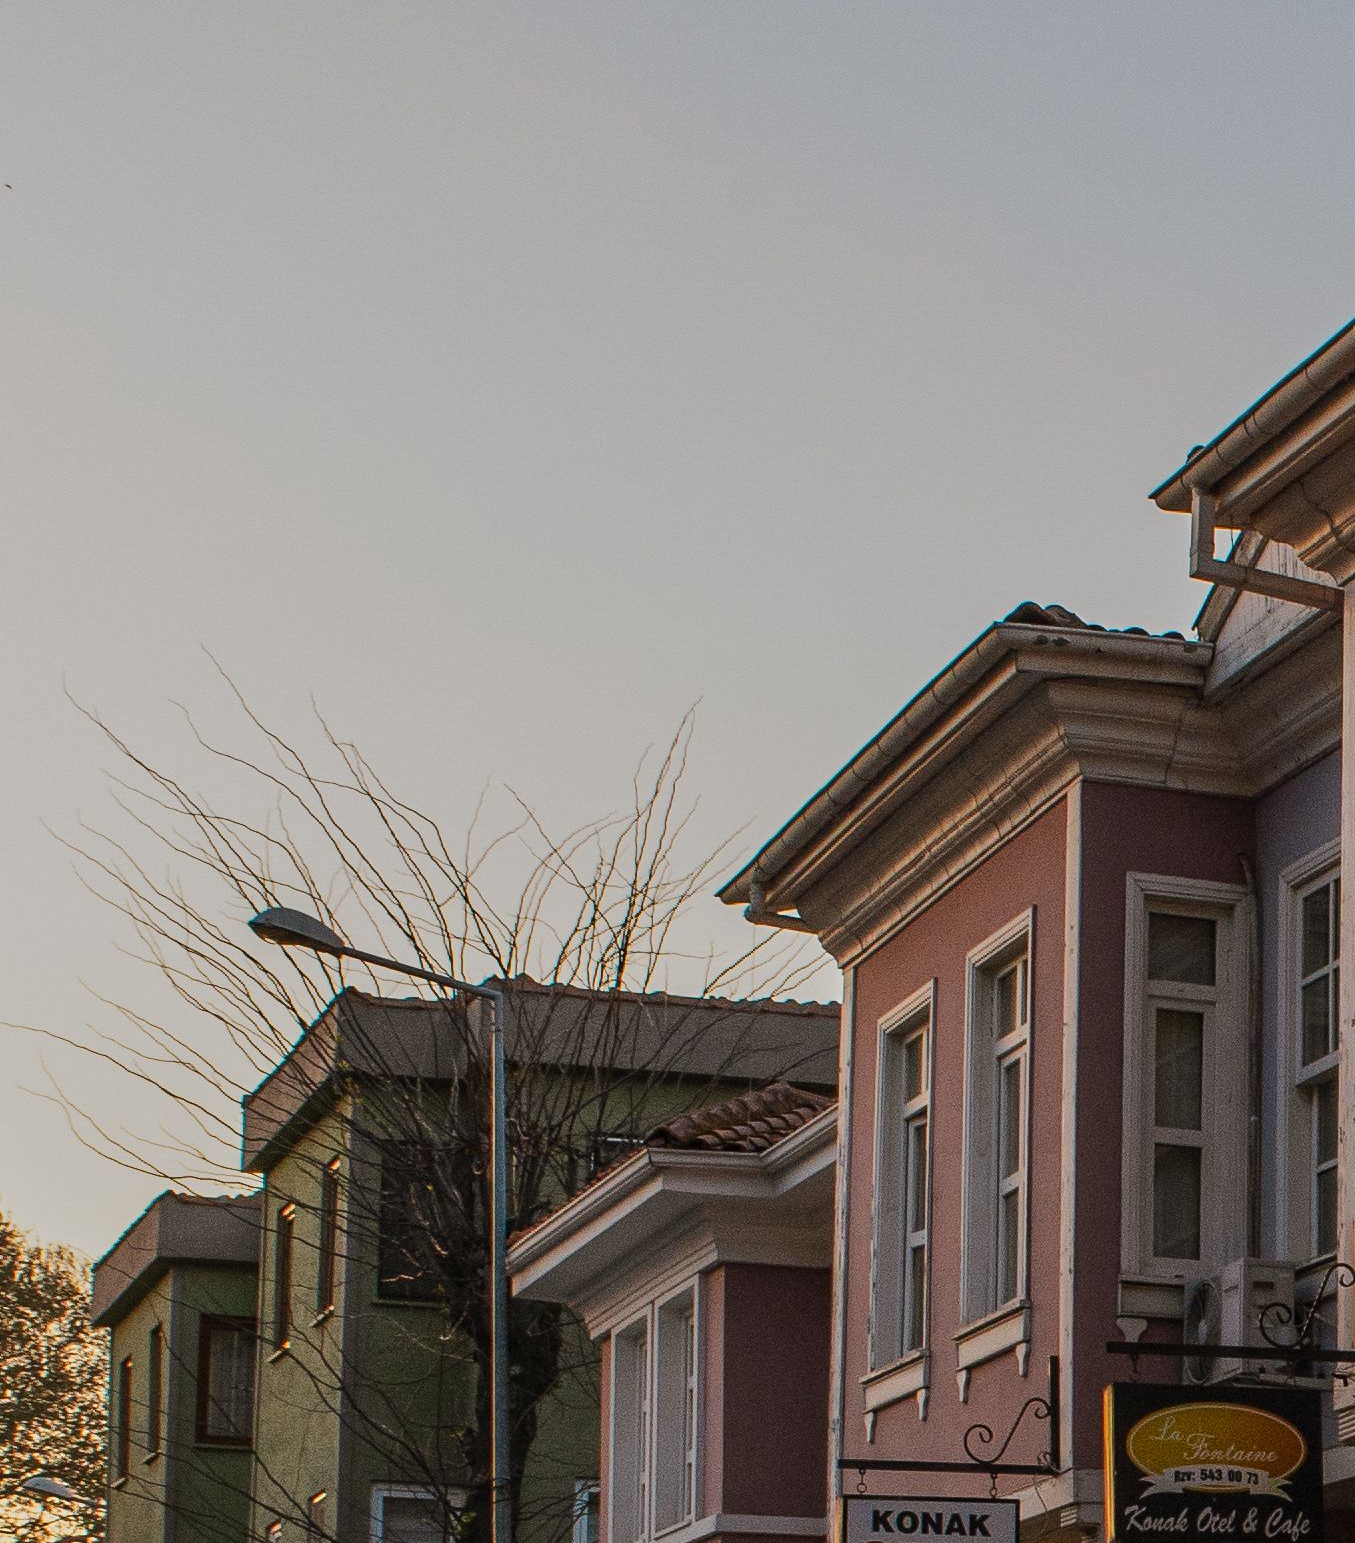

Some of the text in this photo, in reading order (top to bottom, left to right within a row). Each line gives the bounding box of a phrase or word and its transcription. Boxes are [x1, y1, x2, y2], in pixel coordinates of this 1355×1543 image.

[1150, 1415, 1186, 1442] La
[1183, 1432, 1279, 1463] Fontaine
[1200, 1468, 1223, 1482] 543
[1228, 1469, 1242, 1483] 00
[1247, 1471, 1260, 1485] 73
[871, 1509, 992, 1538] KONAK
[1124, 1504, 1311, 1543] Konak Otel & Cafe
